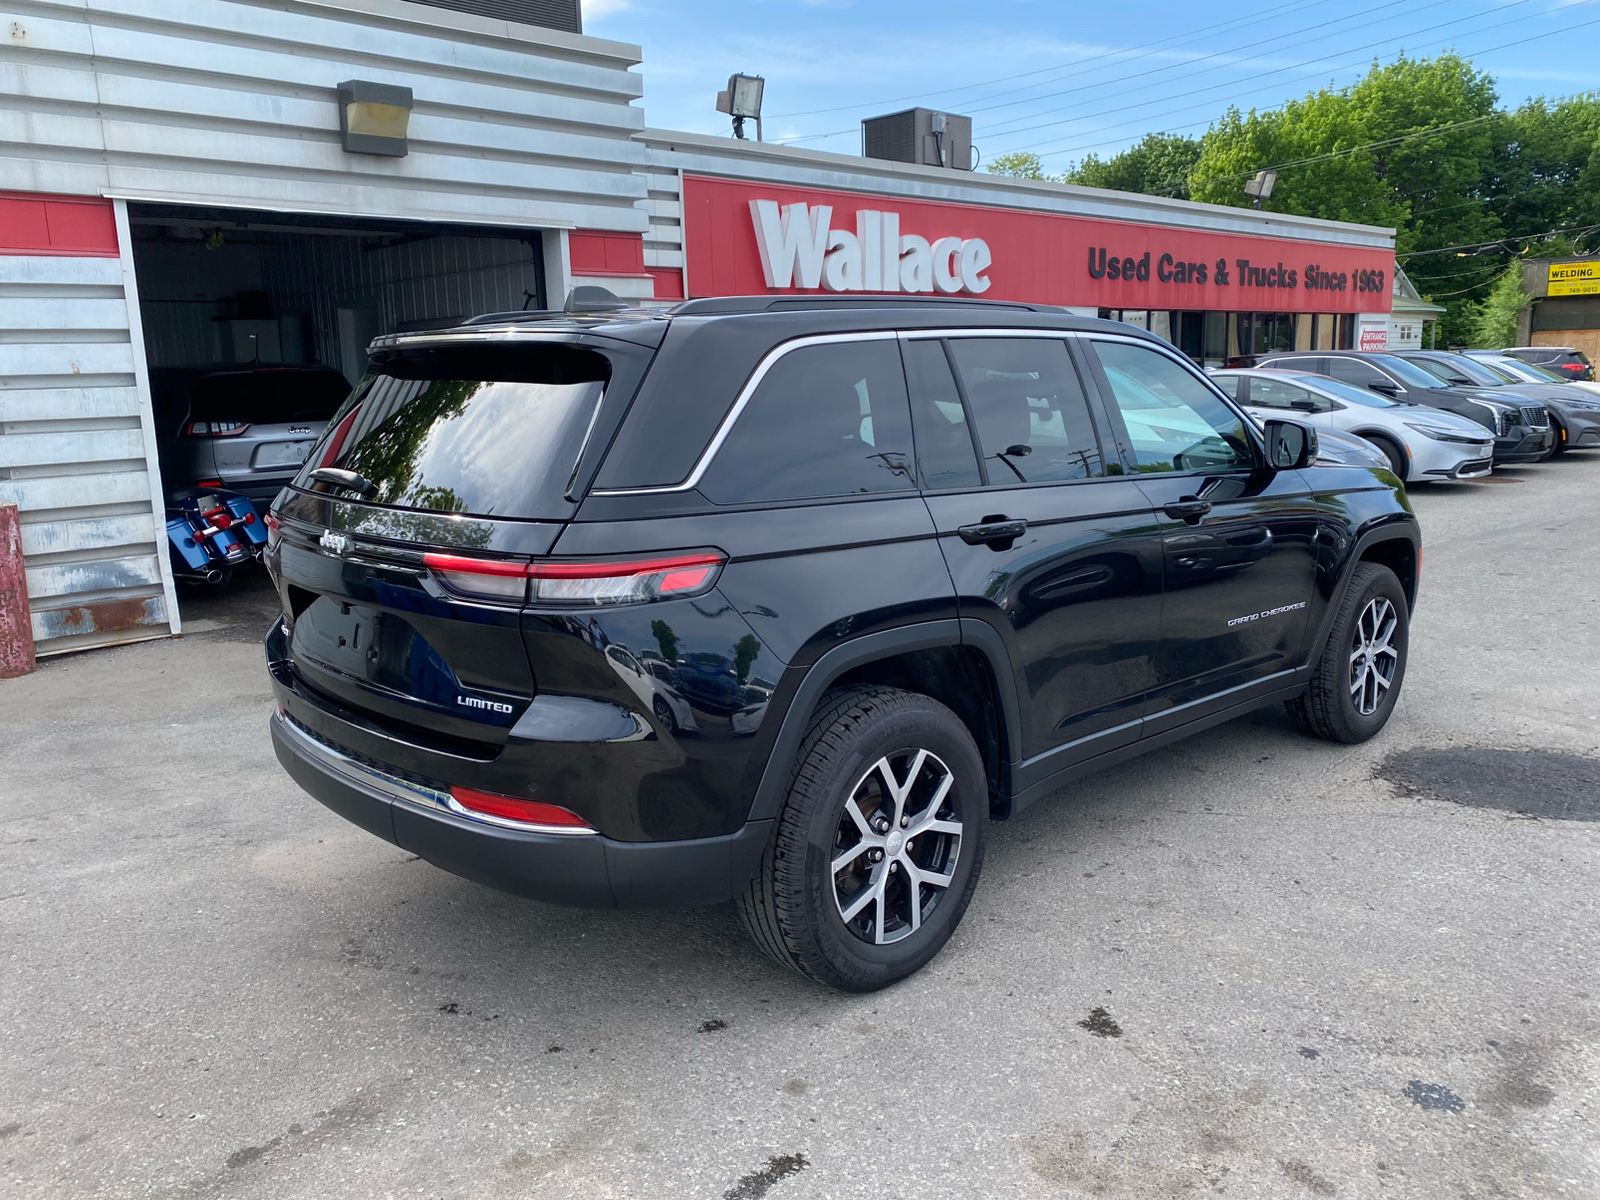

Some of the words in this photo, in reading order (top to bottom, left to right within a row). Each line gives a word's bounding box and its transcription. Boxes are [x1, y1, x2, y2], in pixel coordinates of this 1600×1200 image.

[748, 199, 992, 294] Wallace
[1088, 247, 1151, 280] Used
[1158, 253, 1208, 284] Cars
[1215, 258, 1230, 285] &
[1236, 259, 1298, 288] Trucks
[1304, 264, 1347, 291] Since
[1352, 269, 1385, 293] 1963
[1552, 268, 1593, 278] WELDING
[1363, 343, 1386, 351] PARKING
[288, 425, 312, 434] Jeep
[319, 529, 347, 554] Jeep
[1227, 613, 1259, 627] GRAND
[1260, 601, 1306, 618] CHEROKEE
[457, 695, 513, 714] LIMITED
